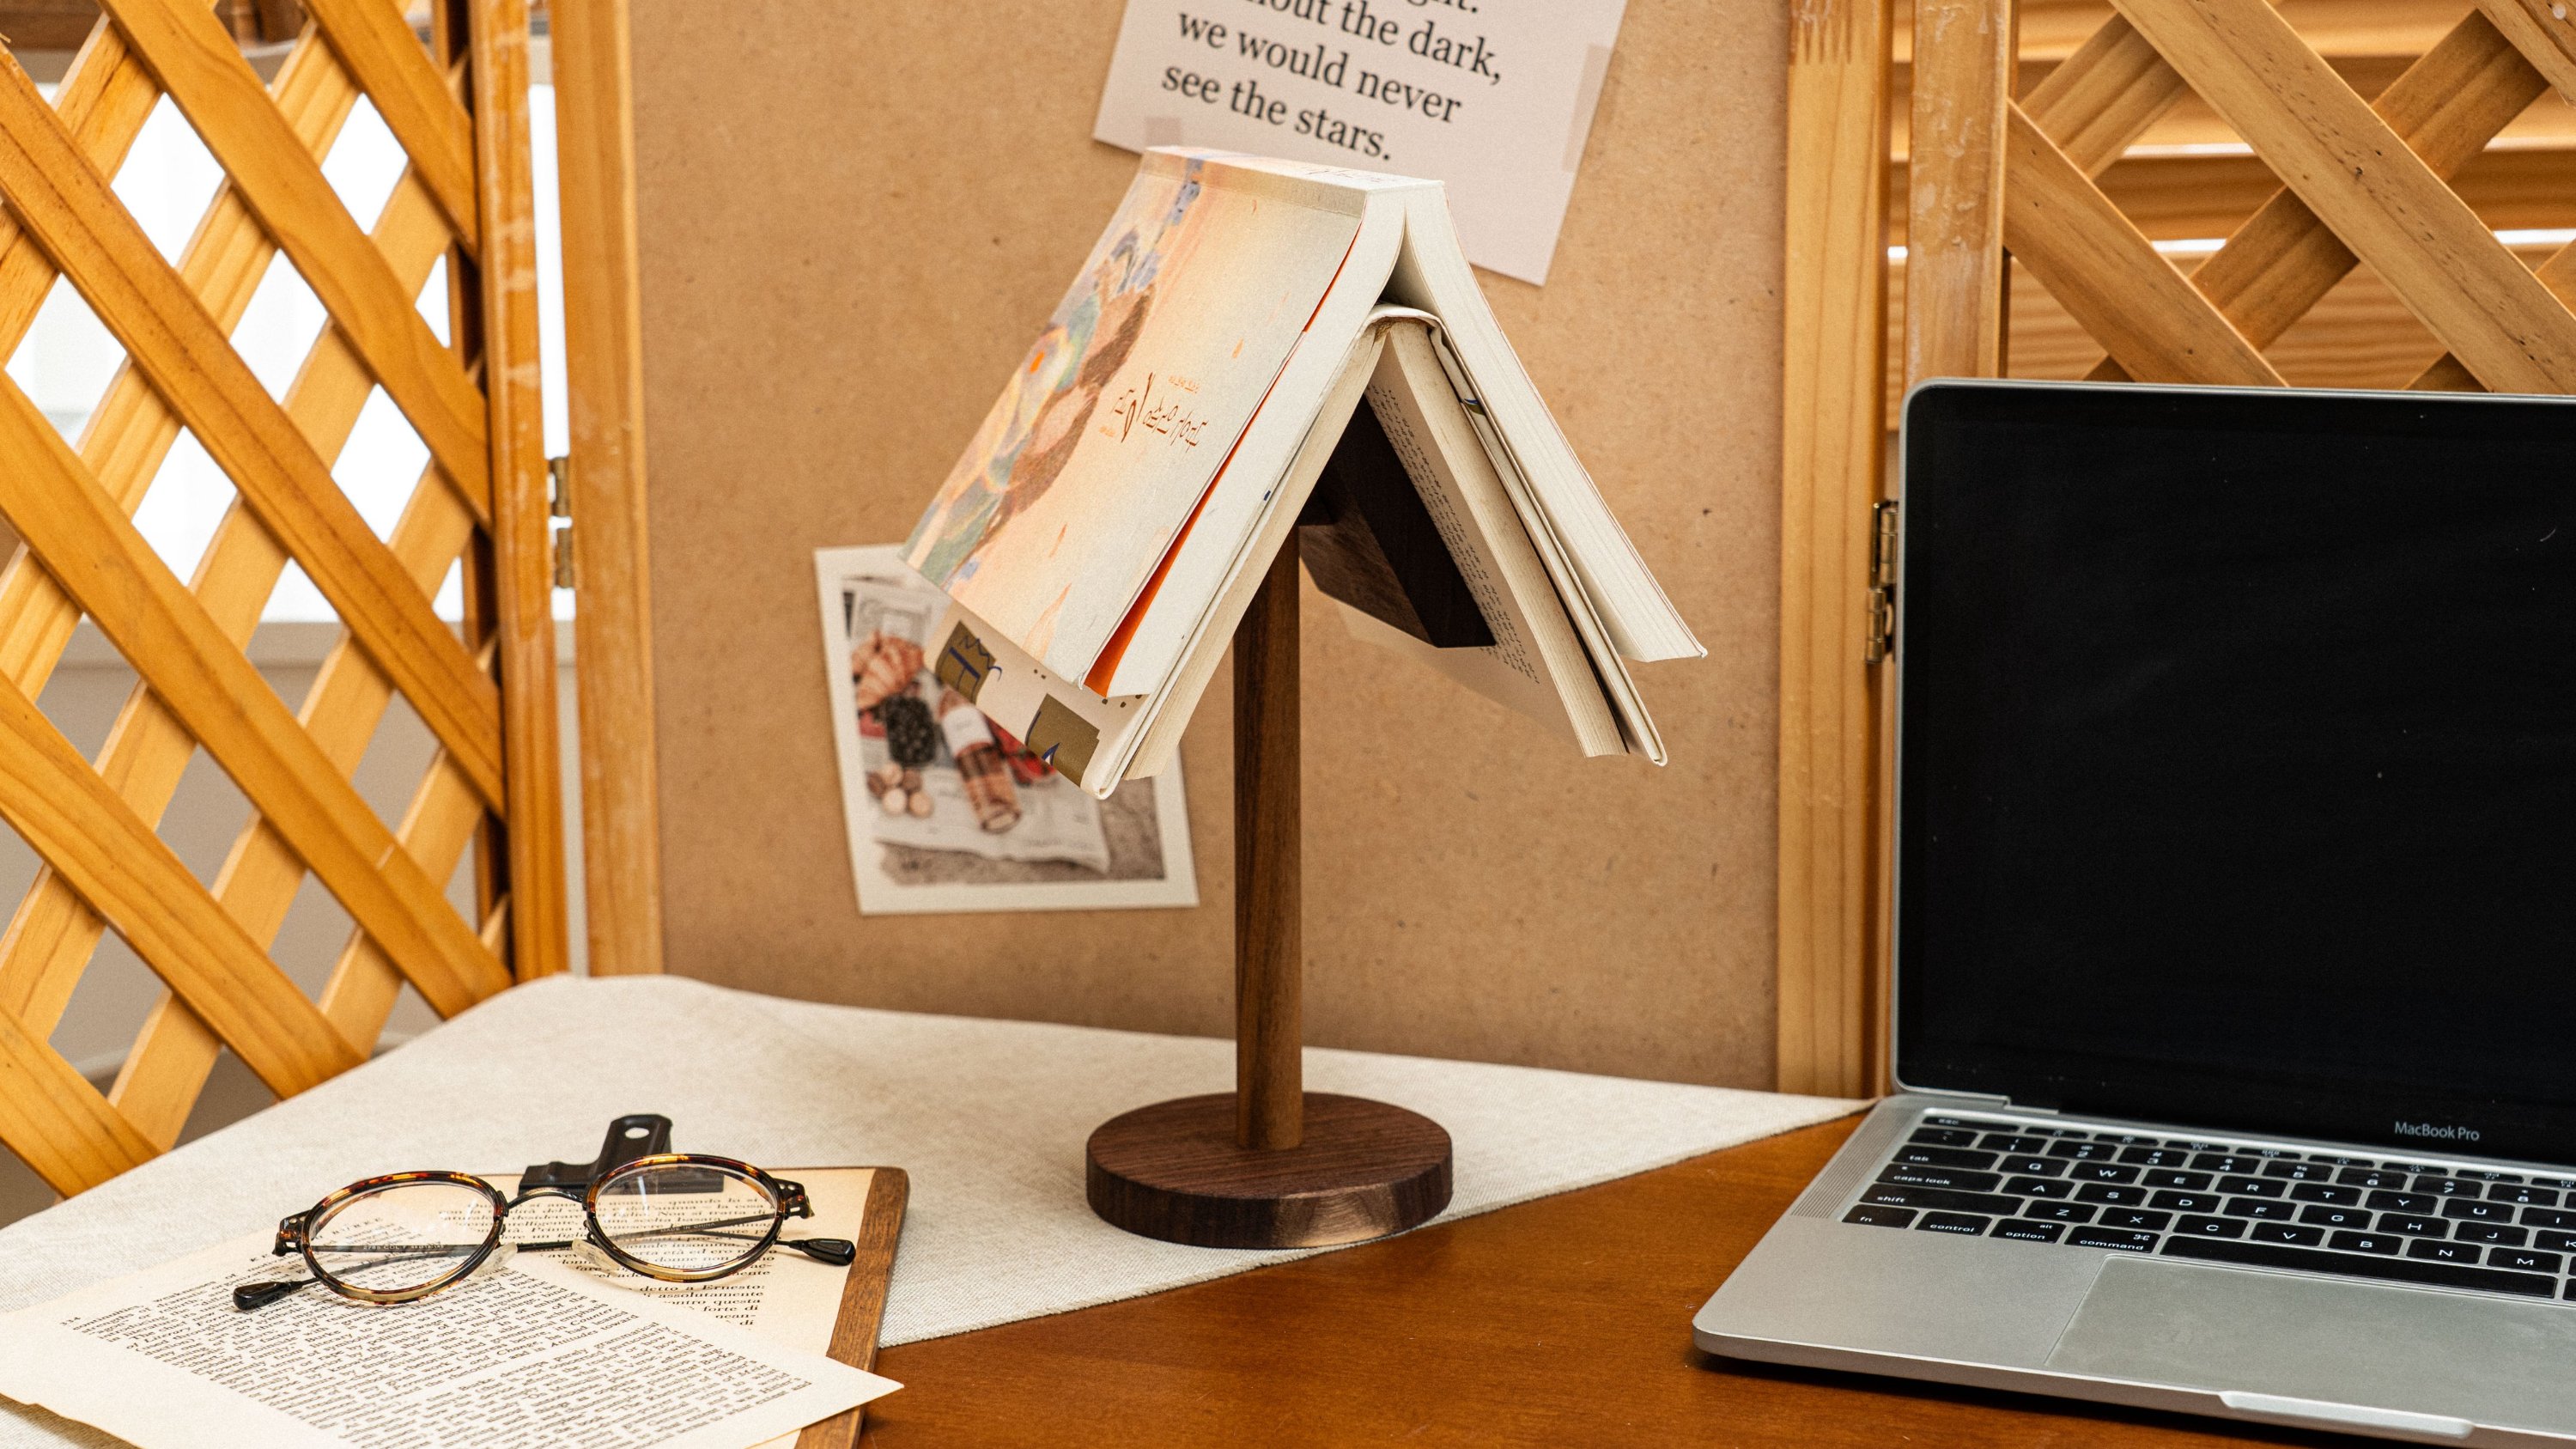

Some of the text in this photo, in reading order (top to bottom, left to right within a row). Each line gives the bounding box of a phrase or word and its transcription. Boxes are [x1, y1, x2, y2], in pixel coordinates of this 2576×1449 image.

[1340, 0, 1400, 46] the
[1408, 20, 1501, 85] dark,
[1179, 12, 1462, 125] we would never
[1162, 62, 1393, 161] see the stars.
[2395, 1121, 2480, 1141] MacBook Pro
[1876, 1195, 1906, 1204] shift
[1858, 1215, 1874, 1224] fn
[1929, 1222, 1976, 1233] control
[2004, 1231, 2046, 1241] option
[2079, 1239, 2145, 1251] command
